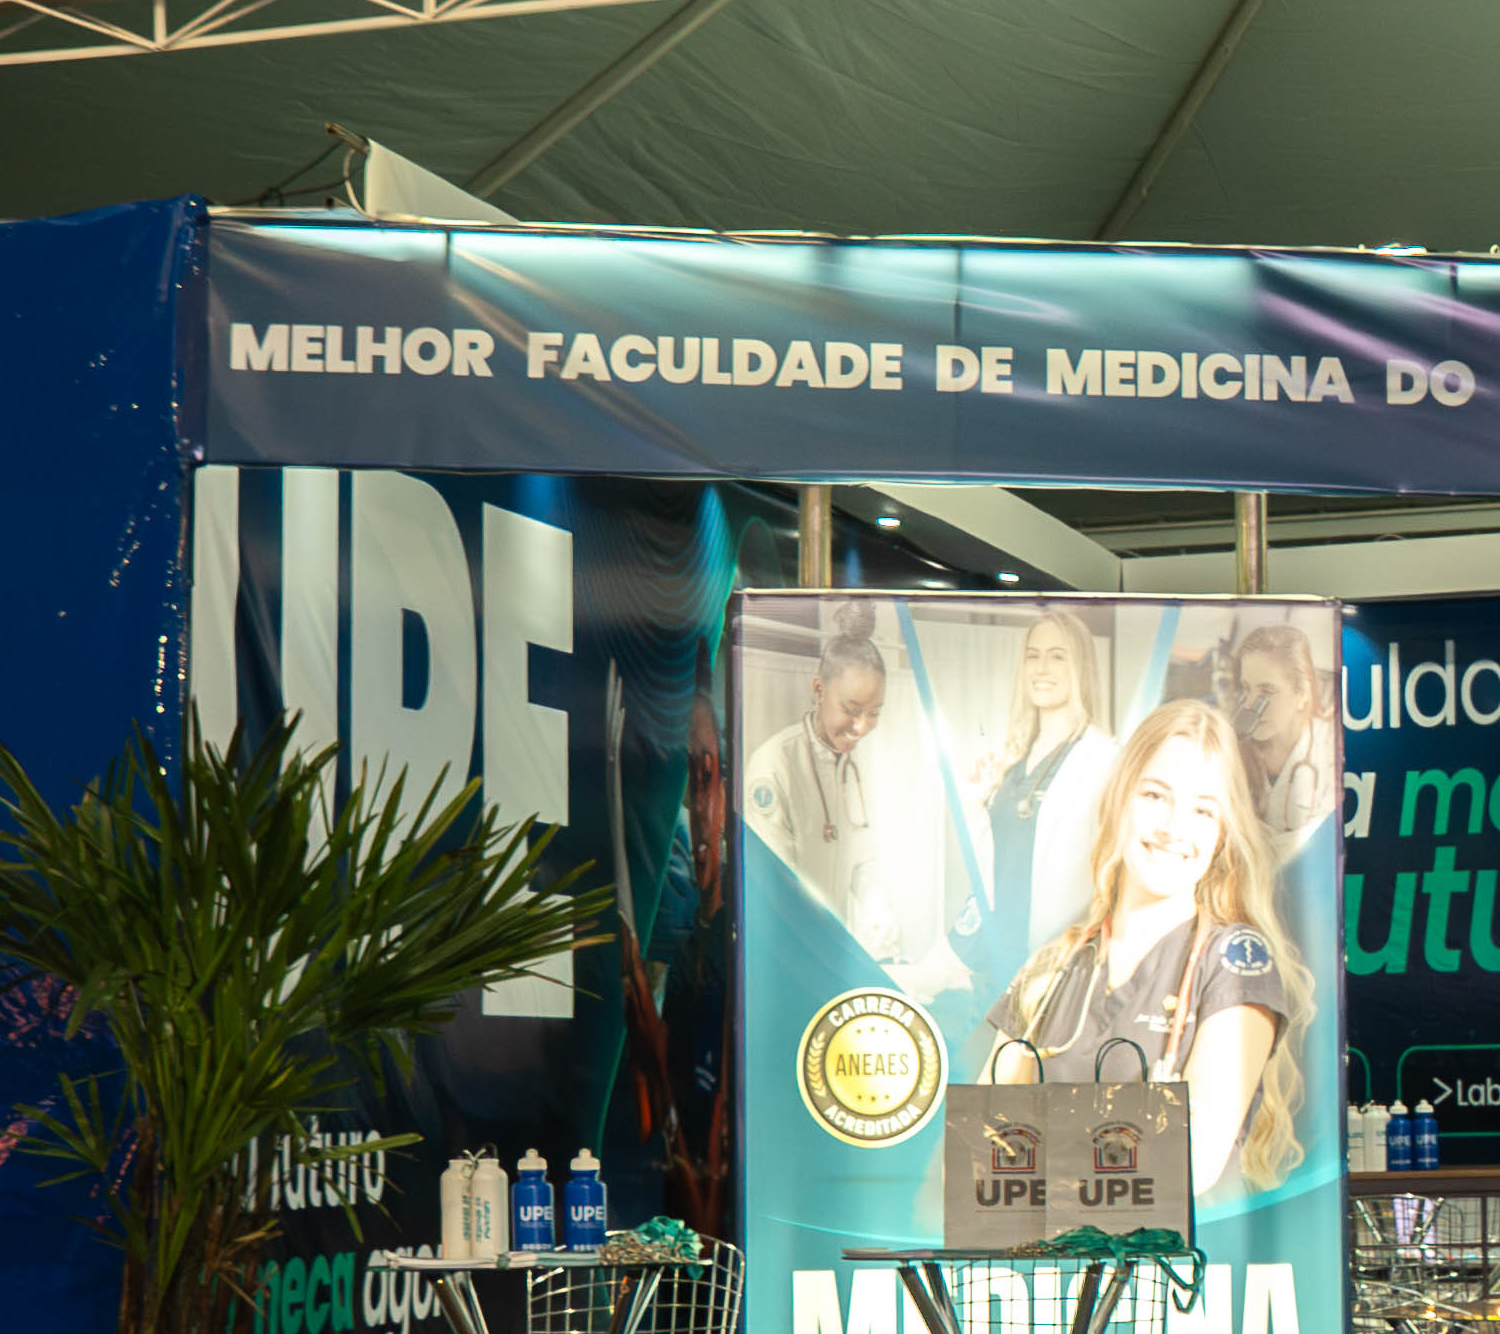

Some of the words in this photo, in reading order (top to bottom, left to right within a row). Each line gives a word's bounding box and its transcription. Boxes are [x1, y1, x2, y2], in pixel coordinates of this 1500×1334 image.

[230, 323, 494, 378] MELHOR
[527, 332, 904, 391] FACULDADE
[935, 345, 1014, 395] DE
[1046, 348, 1355, 405] MEDICINA
[1386, 361, 1476, 408] DO
[827, 995, 916, 1028] CARRERA
[835, 1053, 909, 1076] ANEAES
[824, 1103, 922, 1136] ACREDITADA
[975, 1178, 1047, 1207] UPE
[1078, 1177, 1155, 1207] UPE
[519, 1204, 554, 1222] UPE
[570, 1204, 606, 1223] UPE
